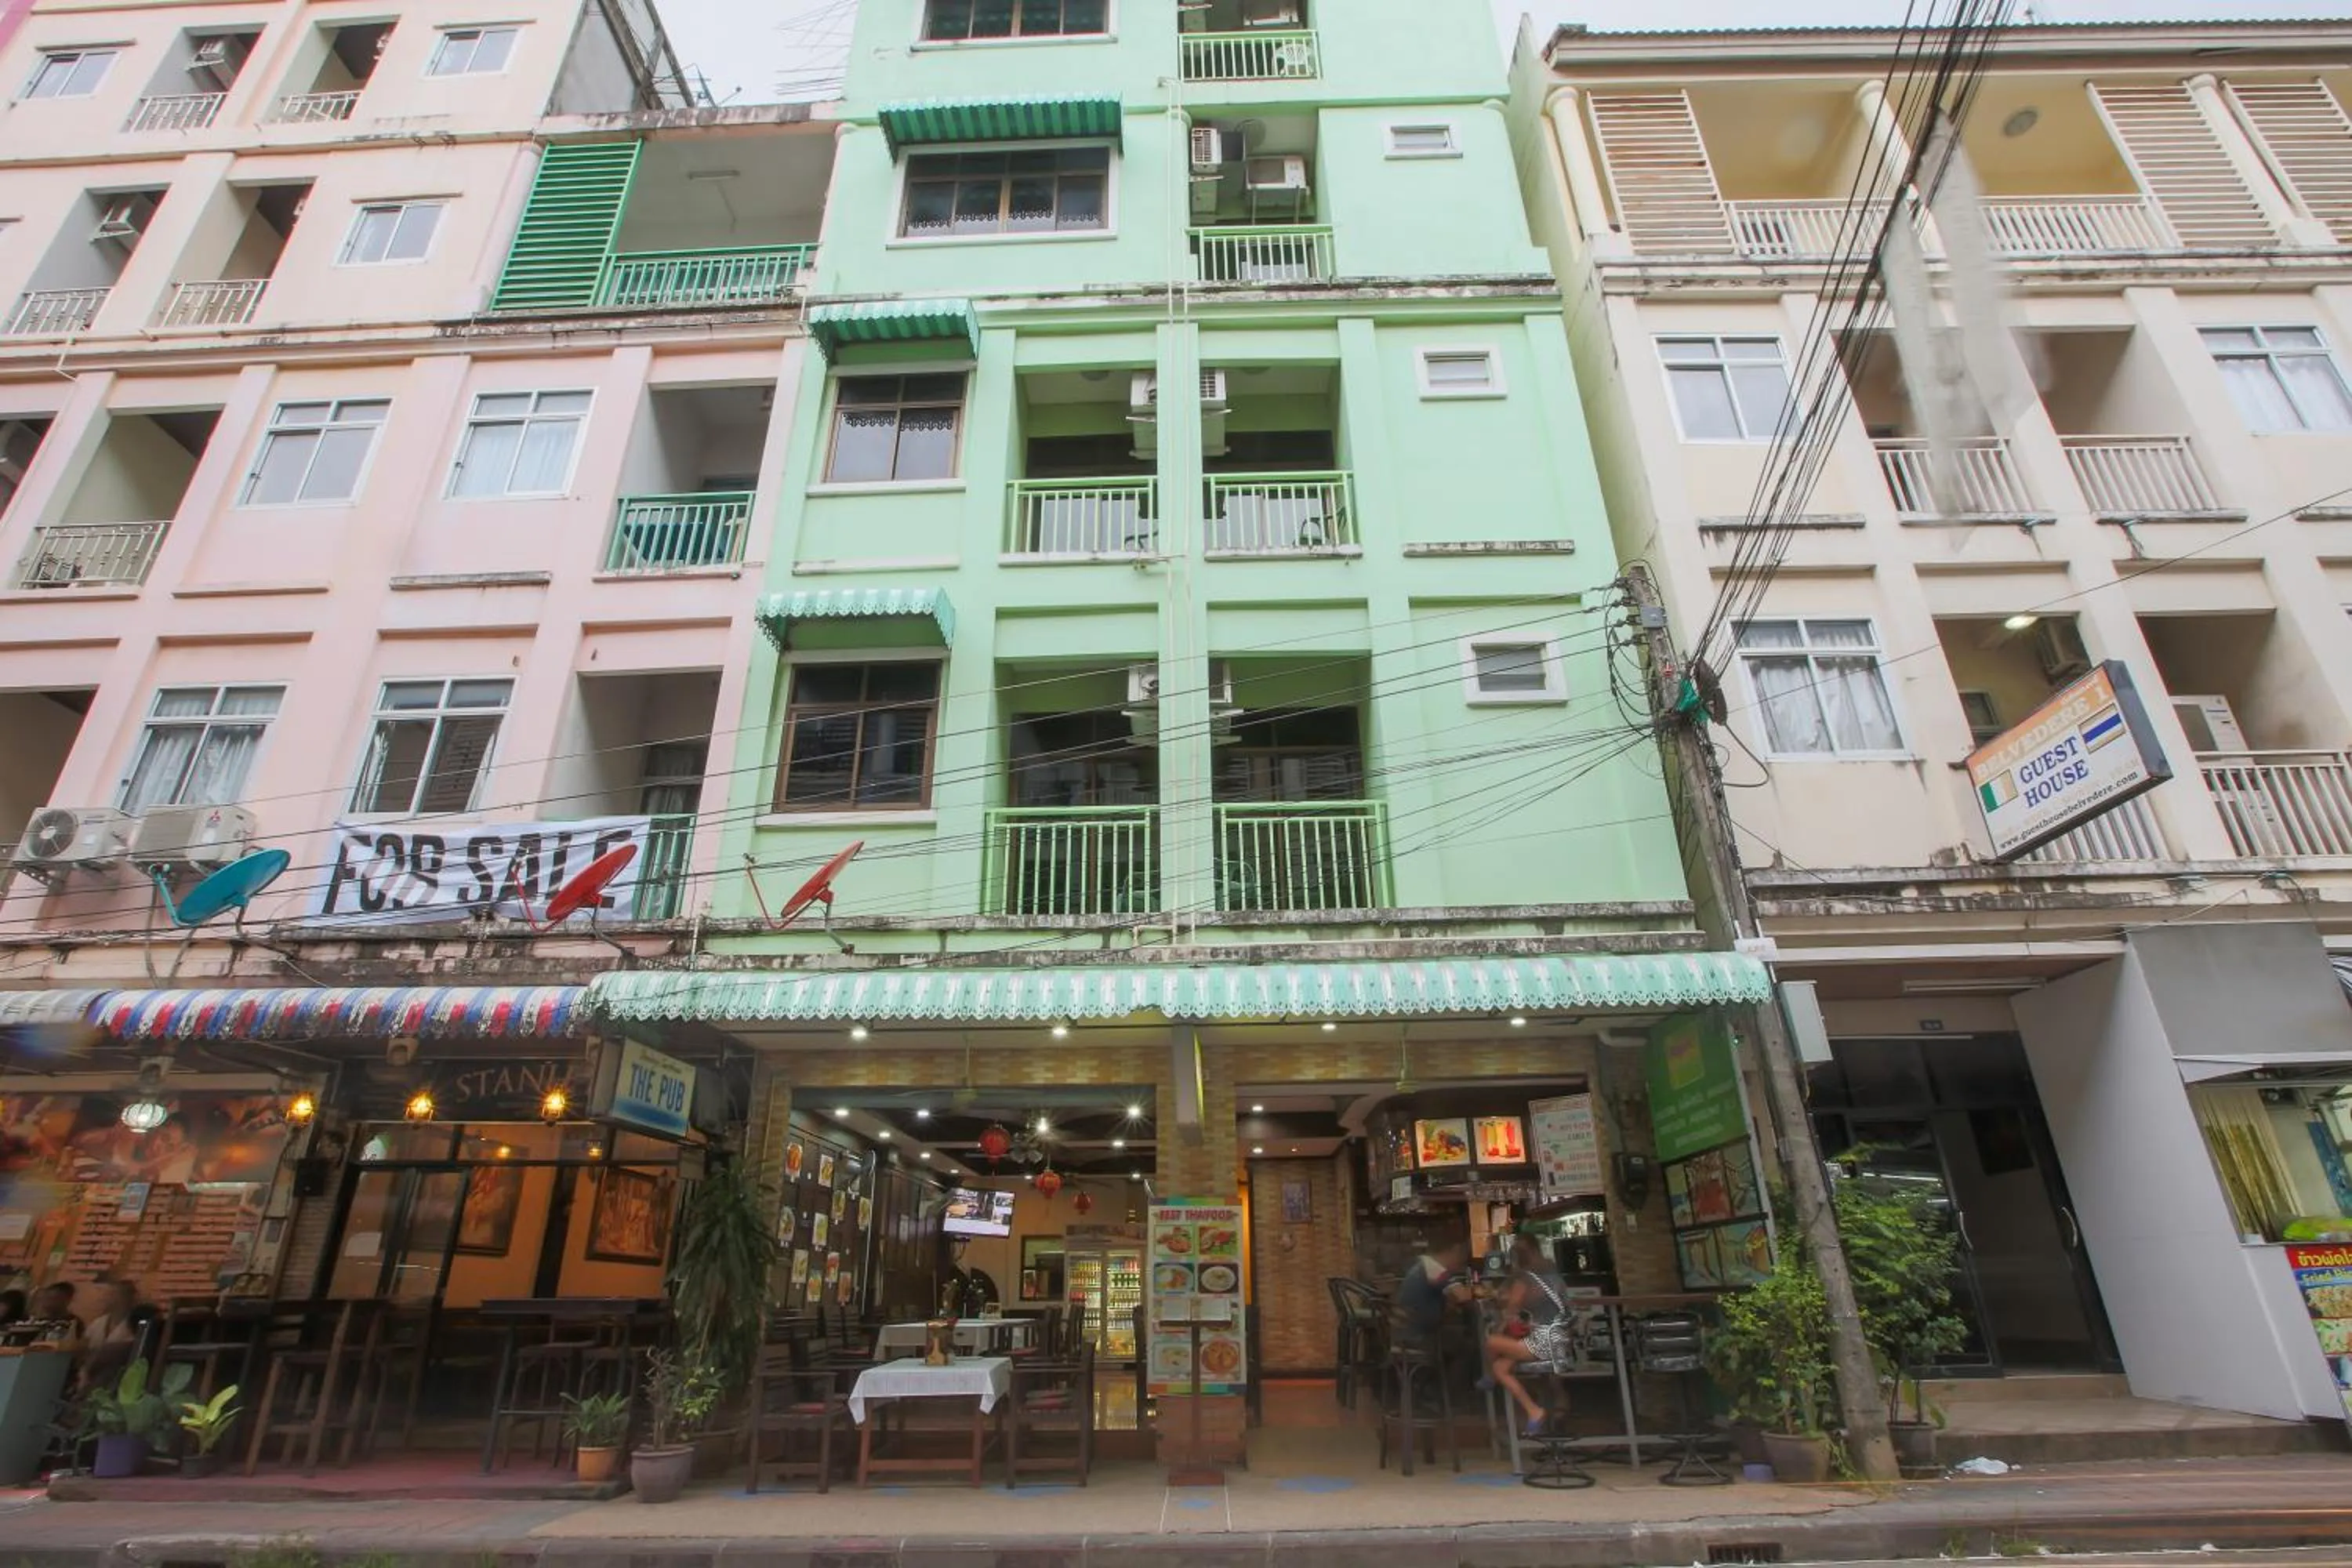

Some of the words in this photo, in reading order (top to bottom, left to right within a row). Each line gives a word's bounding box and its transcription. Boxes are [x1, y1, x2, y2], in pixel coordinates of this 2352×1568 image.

[2019, 735, 2078, 784] GUEST
[2024, 759, 2090, 808] HOUSE
[2000, 771, 2138, 849] www.guesthousebelvedere.com
[321, 833, 446, 915] FOR
[629, 1063, 655, 1103] THE
[657, 1074, 686, 1112] PUB
